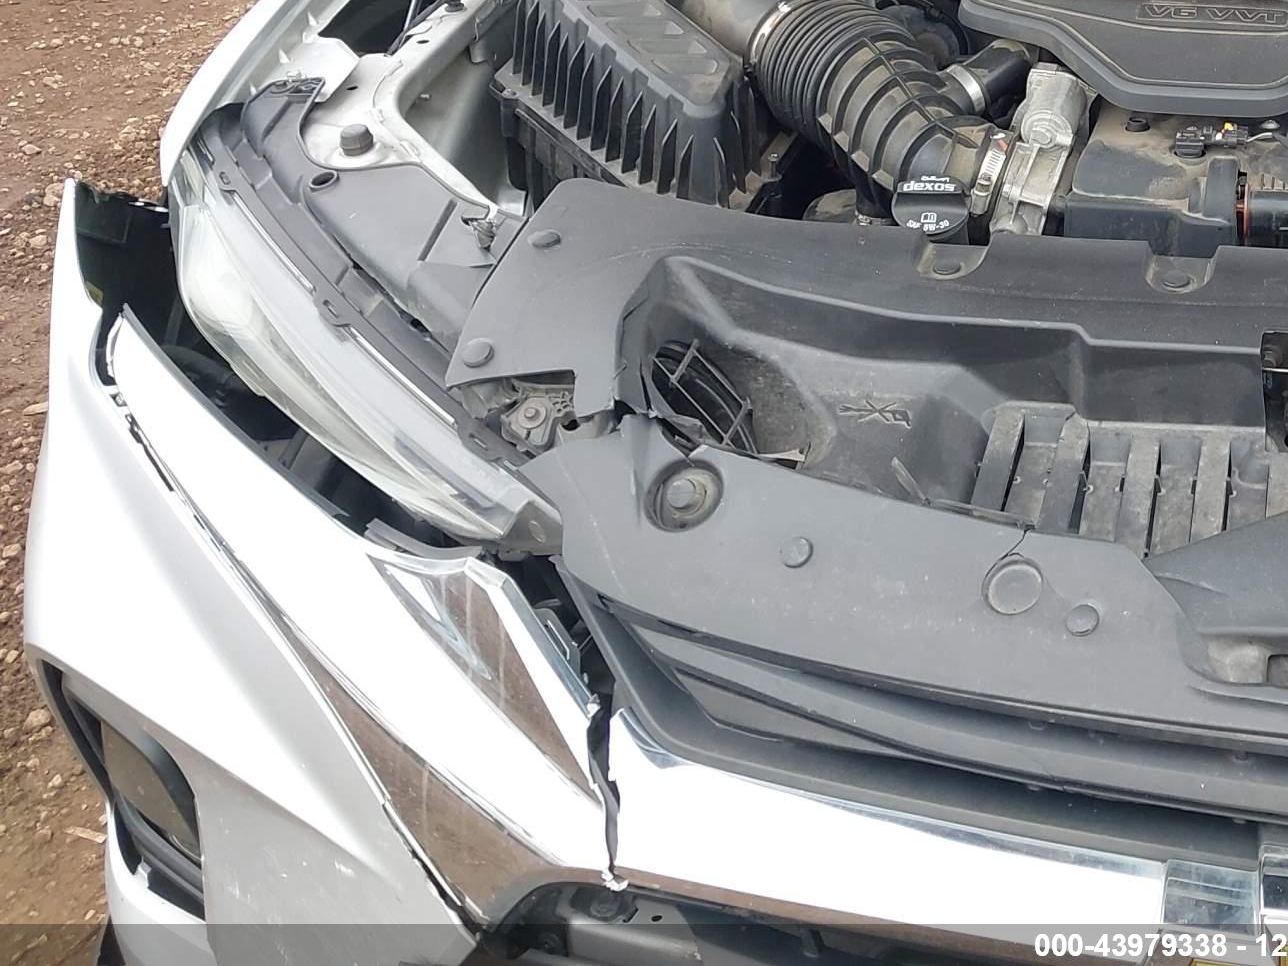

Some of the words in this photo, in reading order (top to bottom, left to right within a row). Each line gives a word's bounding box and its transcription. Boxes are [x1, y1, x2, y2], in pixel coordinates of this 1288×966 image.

[1144, 4, 1198, 18] V6
[1206, 8, 1285, 23] VVT
[903, 181, 956, 192] dexos
[924, 220, 949, 231] 5W-30
